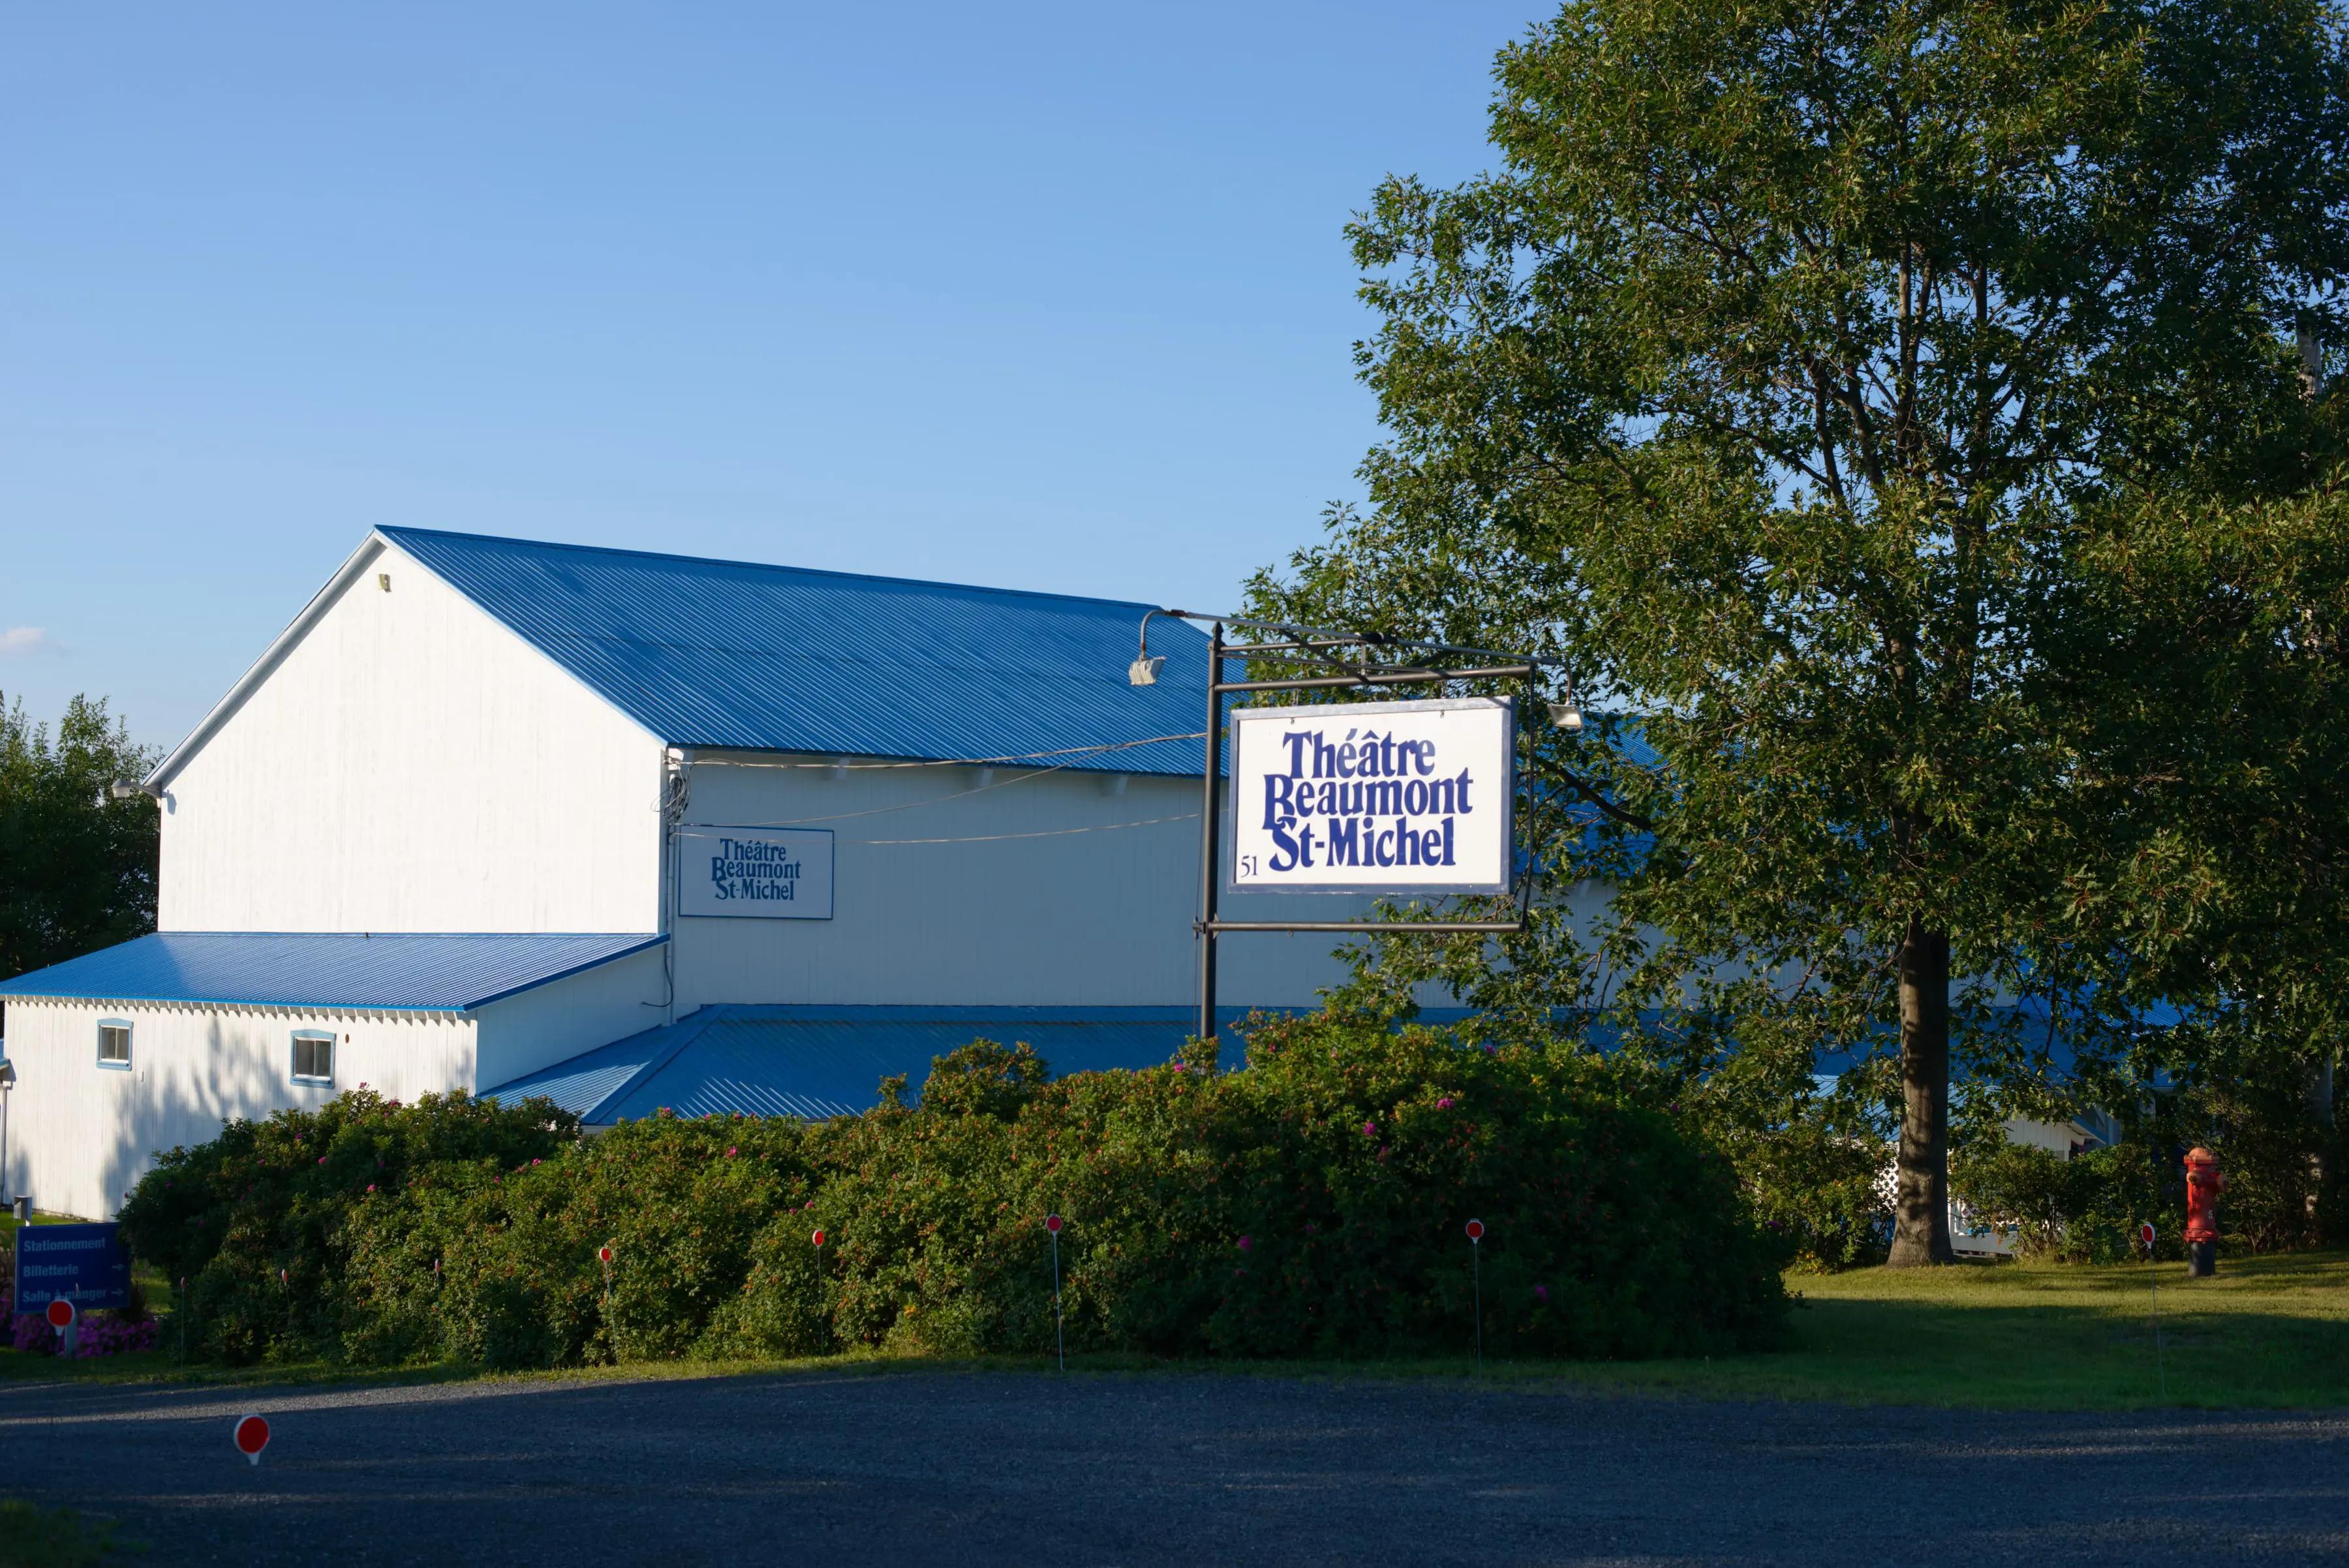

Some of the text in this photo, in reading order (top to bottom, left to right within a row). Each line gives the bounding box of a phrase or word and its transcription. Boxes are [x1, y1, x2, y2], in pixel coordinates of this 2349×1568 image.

[1282, 728, 1436, 779] Théâtre
[1262, 767, 1473, 829] Beaumont
[720, 838, 787, 861] Théâtre
[1269, 816, 1456, 871] St-Michel
[711, 857, 801, 881] Beaumont
[1240, 855, 1258, 877] 51
[715, 878, 794, 900] St-Michel
[23, 1237, 106, 1252] Stationnement
[23, 1264, 79, 1278] Billetterie
[23, 1289, 51, 1303] Salle
[65, 1289, 107, 1302] manger
